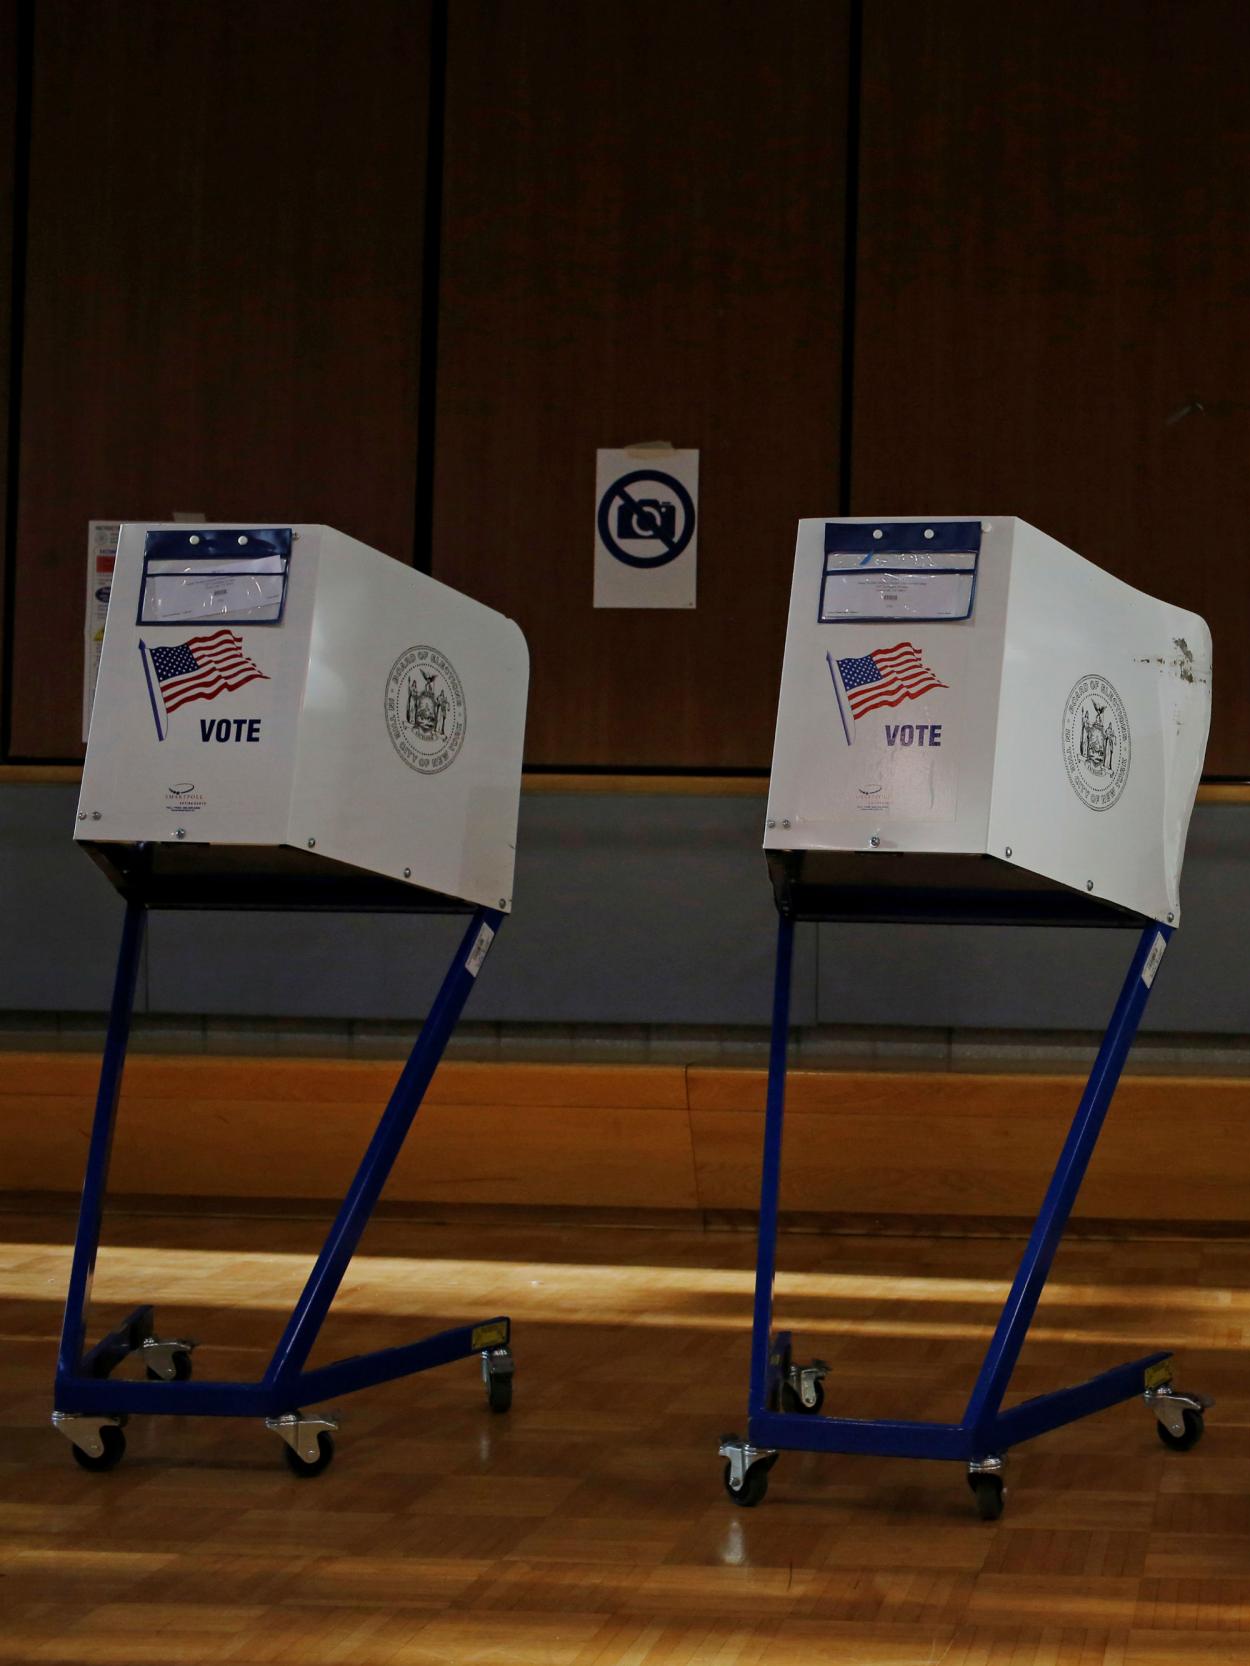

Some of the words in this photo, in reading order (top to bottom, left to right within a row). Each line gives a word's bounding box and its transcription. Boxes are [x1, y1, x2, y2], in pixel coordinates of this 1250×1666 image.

[392, 653, 416, 684] BOARD
[417, 651, 430, 661] OF
[430, 653, 463, 707] ELECTIONS
[1069, 682, 1089, 714] BOARD
[1090, 680, 1100, 690] OF
[200, 719, 261, 743] VOTE
[884, 724, 942, 747] VOTE
